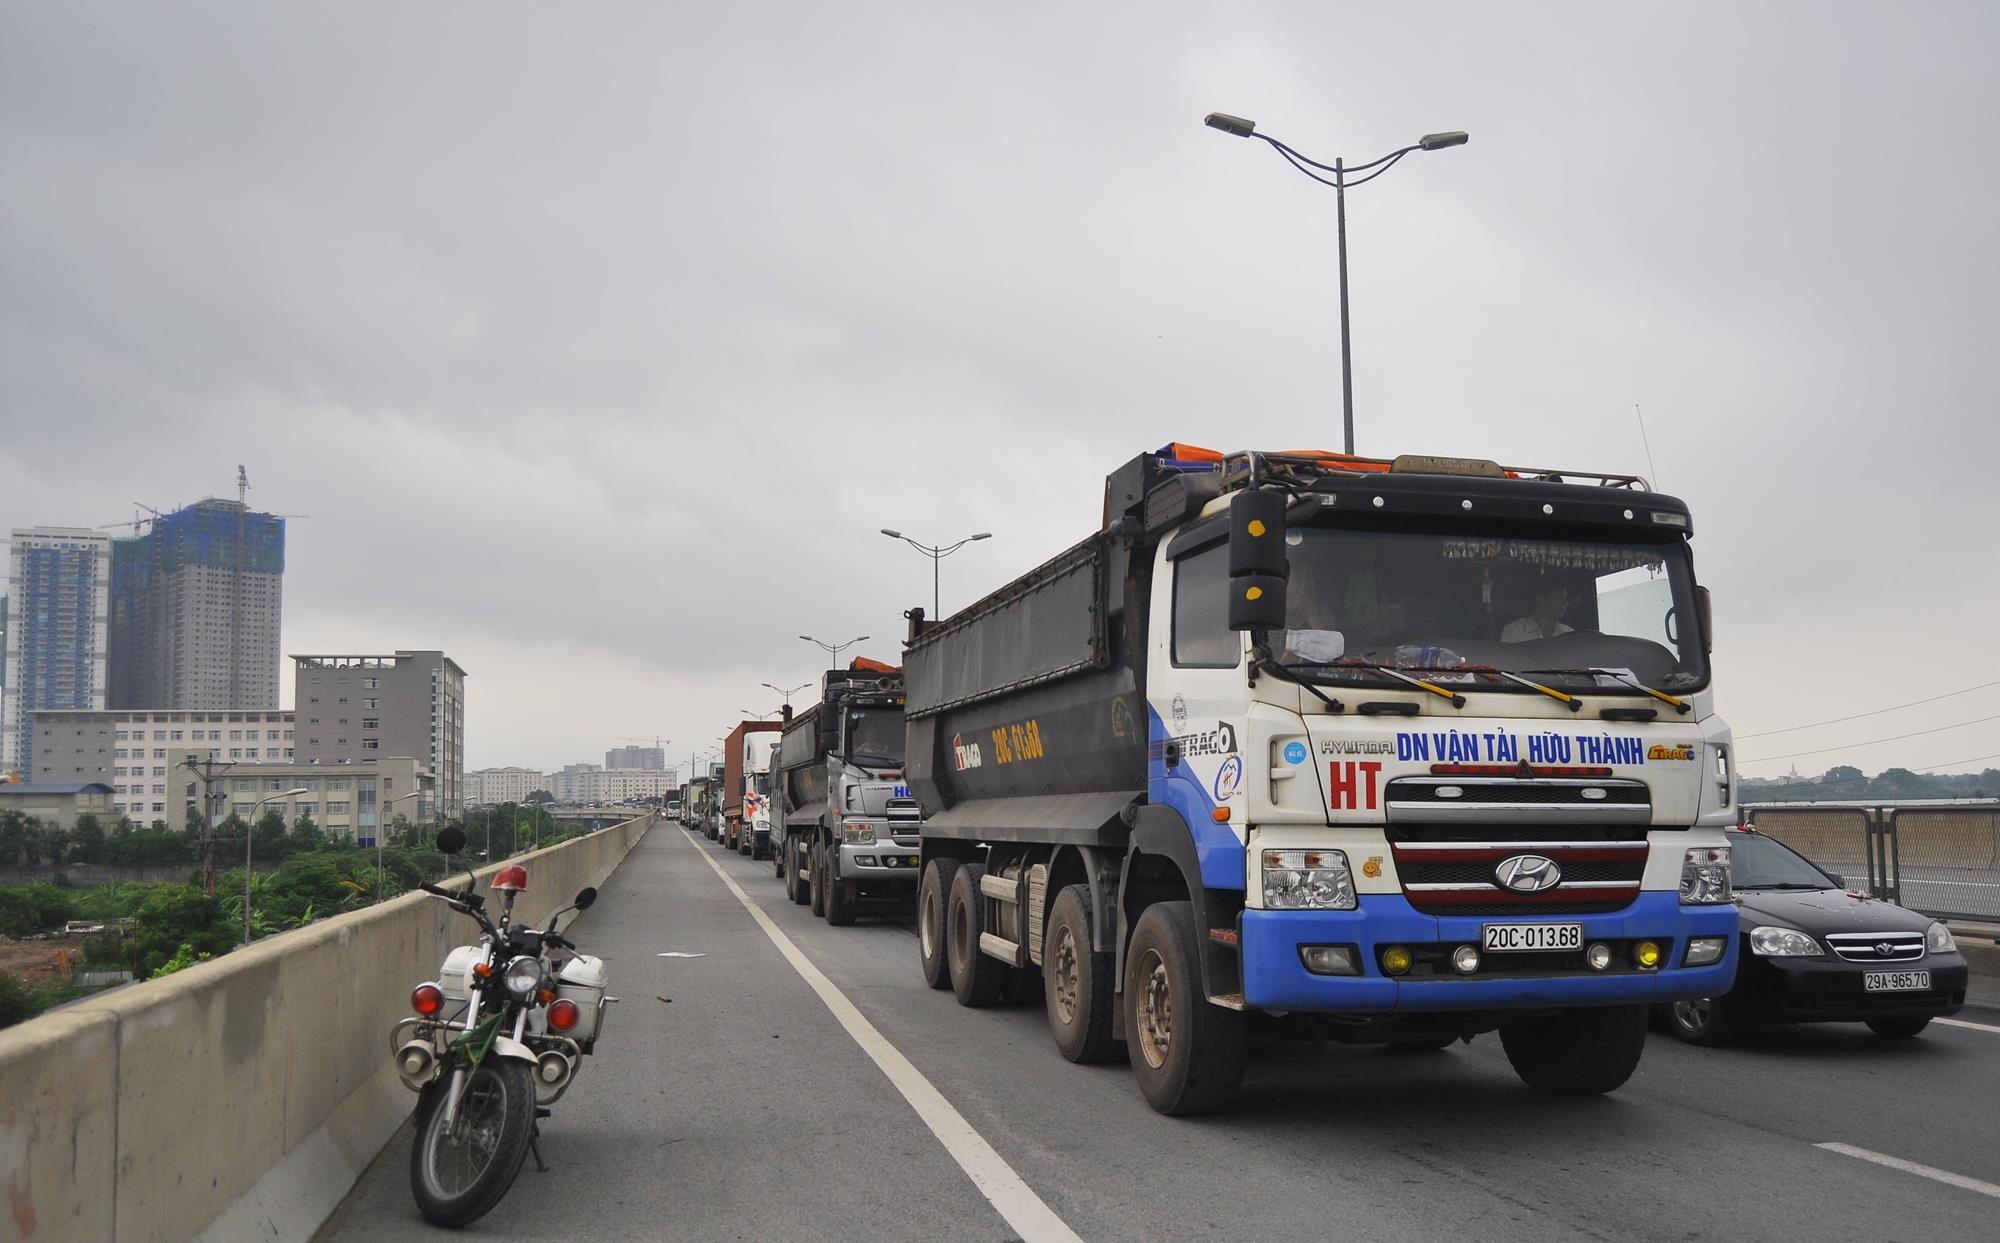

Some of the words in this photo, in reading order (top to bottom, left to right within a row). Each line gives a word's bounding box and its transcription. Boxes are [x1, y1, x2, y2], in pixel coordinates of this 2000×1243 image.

[1321, 741, 1395, 754] HYUNDAI
[1397, 733, 1429, 761] DN
[1433, 729, 1479, 765] VẬN
[1483, 727, 1518, 762] TẢI
[1528, 731, 1571, 764] HỮU
[1576, 732, 1644, 765] THÀNH
[1330, 762, 1381, 809] HT
[1488, 927, 1579, 947] 20C-013.68
[1867, 973, 1928, 989] 29A-965.70
